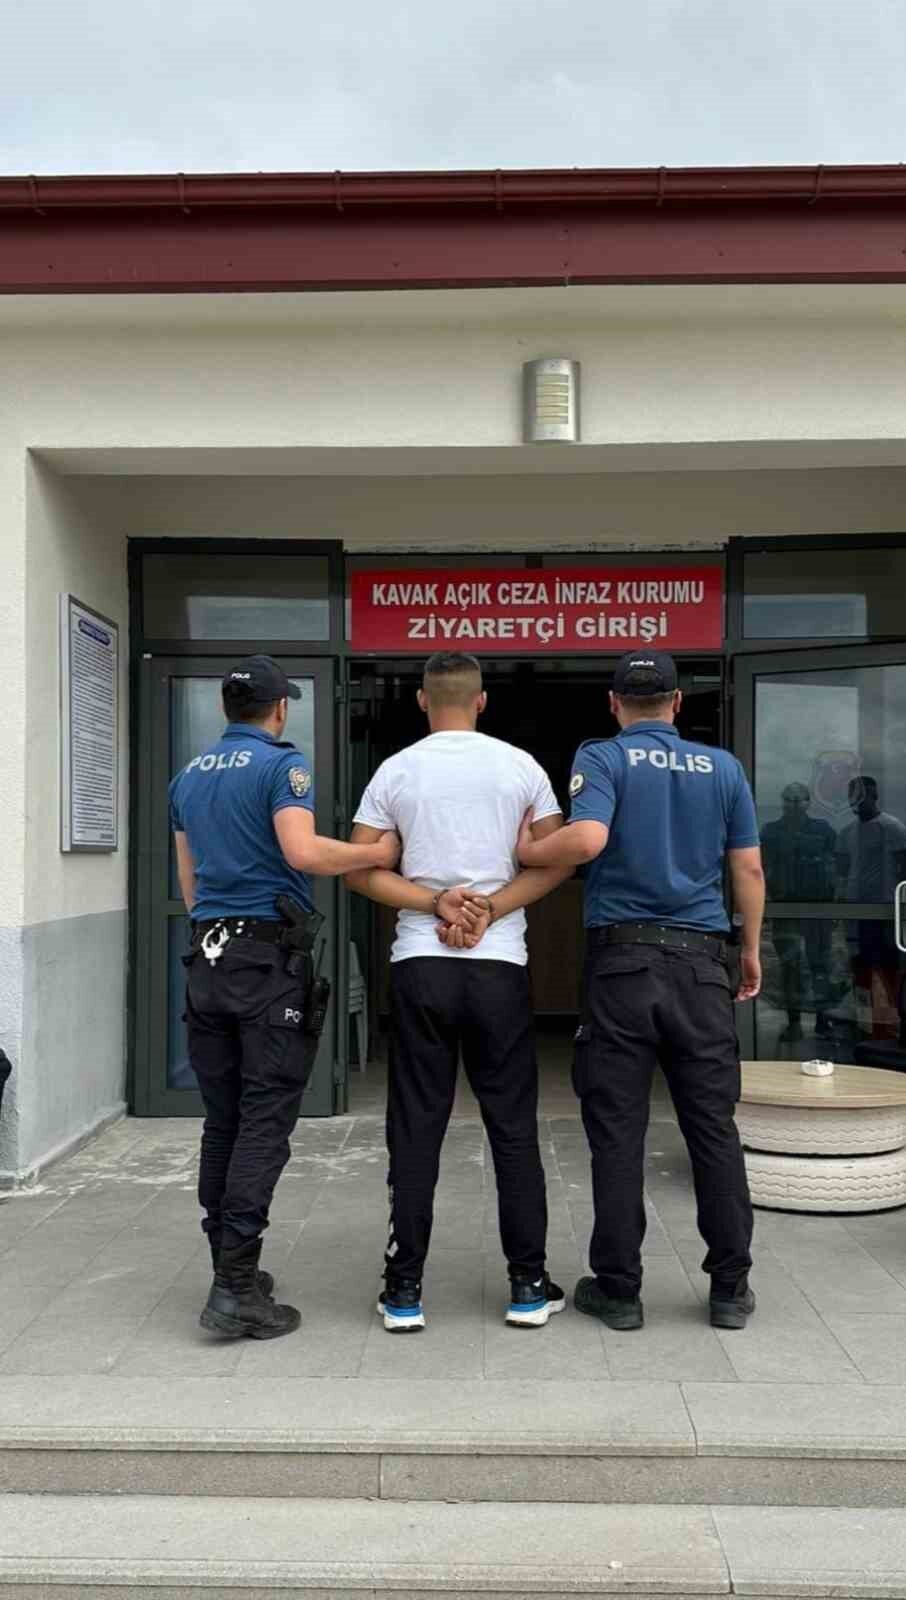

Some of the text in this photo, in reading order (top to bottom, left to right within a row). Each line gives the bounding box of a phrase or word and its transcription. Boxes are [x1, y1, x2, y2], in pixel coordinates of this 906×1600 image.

[372, 577, 704, 611] KAVAK AÇIK CEZA İNFAZ KURUMU
[407, 611, 668, 643] ZİYARETÇİ GİRİŞİ
